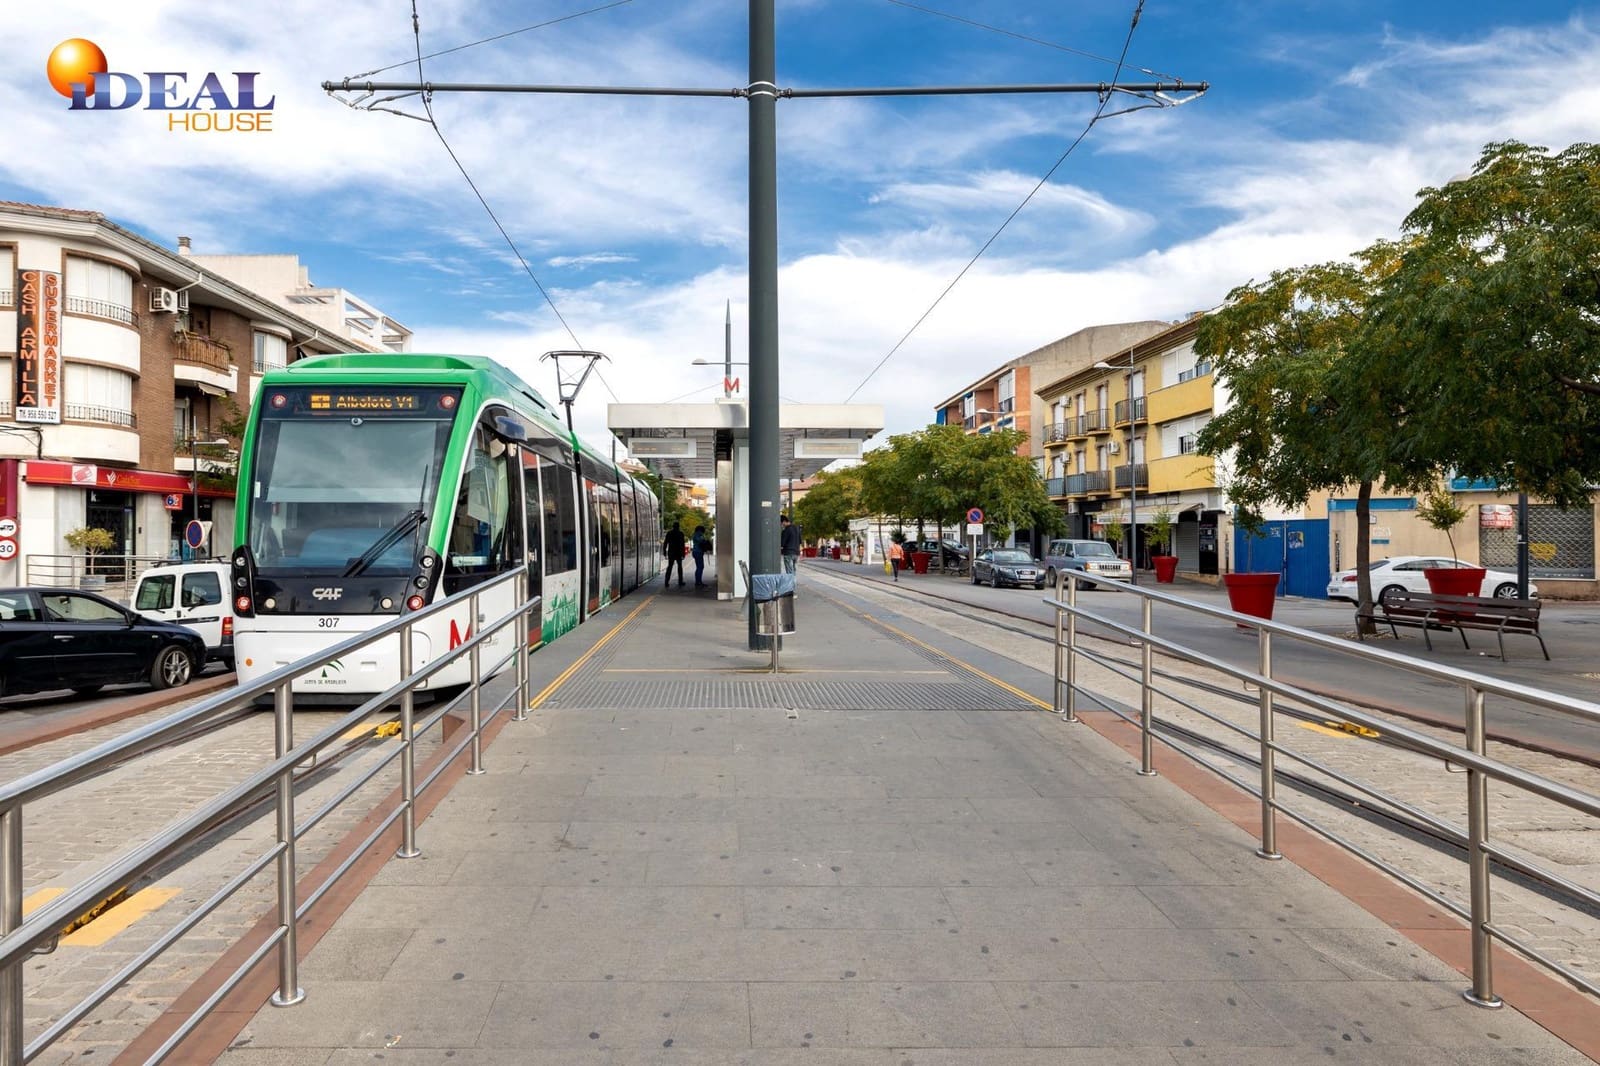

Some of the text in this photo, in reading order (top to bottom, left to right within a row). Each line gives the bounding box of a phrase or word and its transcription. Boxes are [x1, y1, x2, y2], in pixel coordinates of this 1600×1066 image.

[20, 271, 37, 404] CASH ARMILLA
[44, 274, 58, 407] SUPERMARKET
[724, 377, 739, 393] M
[396, 395, 413, 408] V1
[0, 545, 13, 553] 30
[312, 588, 343, 600] CAF
[318, 618, 340, 628] 307
